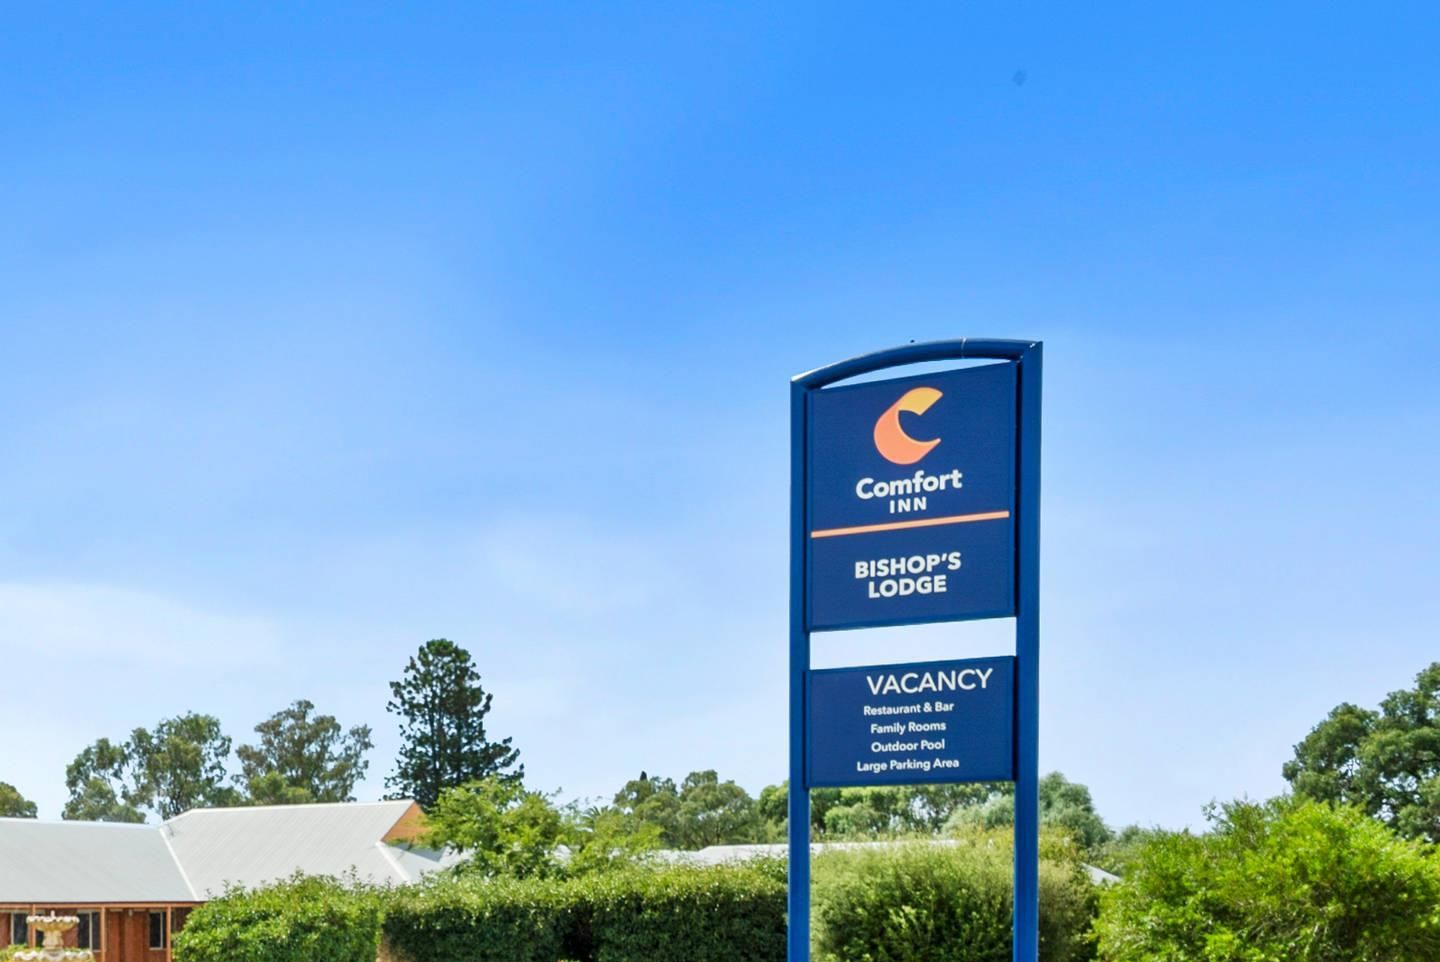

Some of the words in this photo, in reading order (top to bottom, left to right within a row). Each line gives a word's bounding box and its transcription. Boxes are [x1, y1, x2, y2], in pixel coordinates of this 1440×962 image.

[855, 469, 963, 500] Comfort
[889, 496, 927, 514] INN
[854, 551, 962, 579] BISHOP'S
[868, 574, 948, 599] LODGE
[866, 667, 994, 696] VACANCY
[863, 703, 922, 716] Restaurant
[923, 701, 933, 713] &
[934, 701, 955, 713] Bar
[870, 722, 906, 736] Family
[908, 721, 947, 733] Rooms
[870, 740, 919, 753] Outdoor
[920, 738, 946, 751] Pool
[856, 760, 888, 774] Large
[889, 757, 931, 772] Parking
[932, 757, 960, 769] Area
